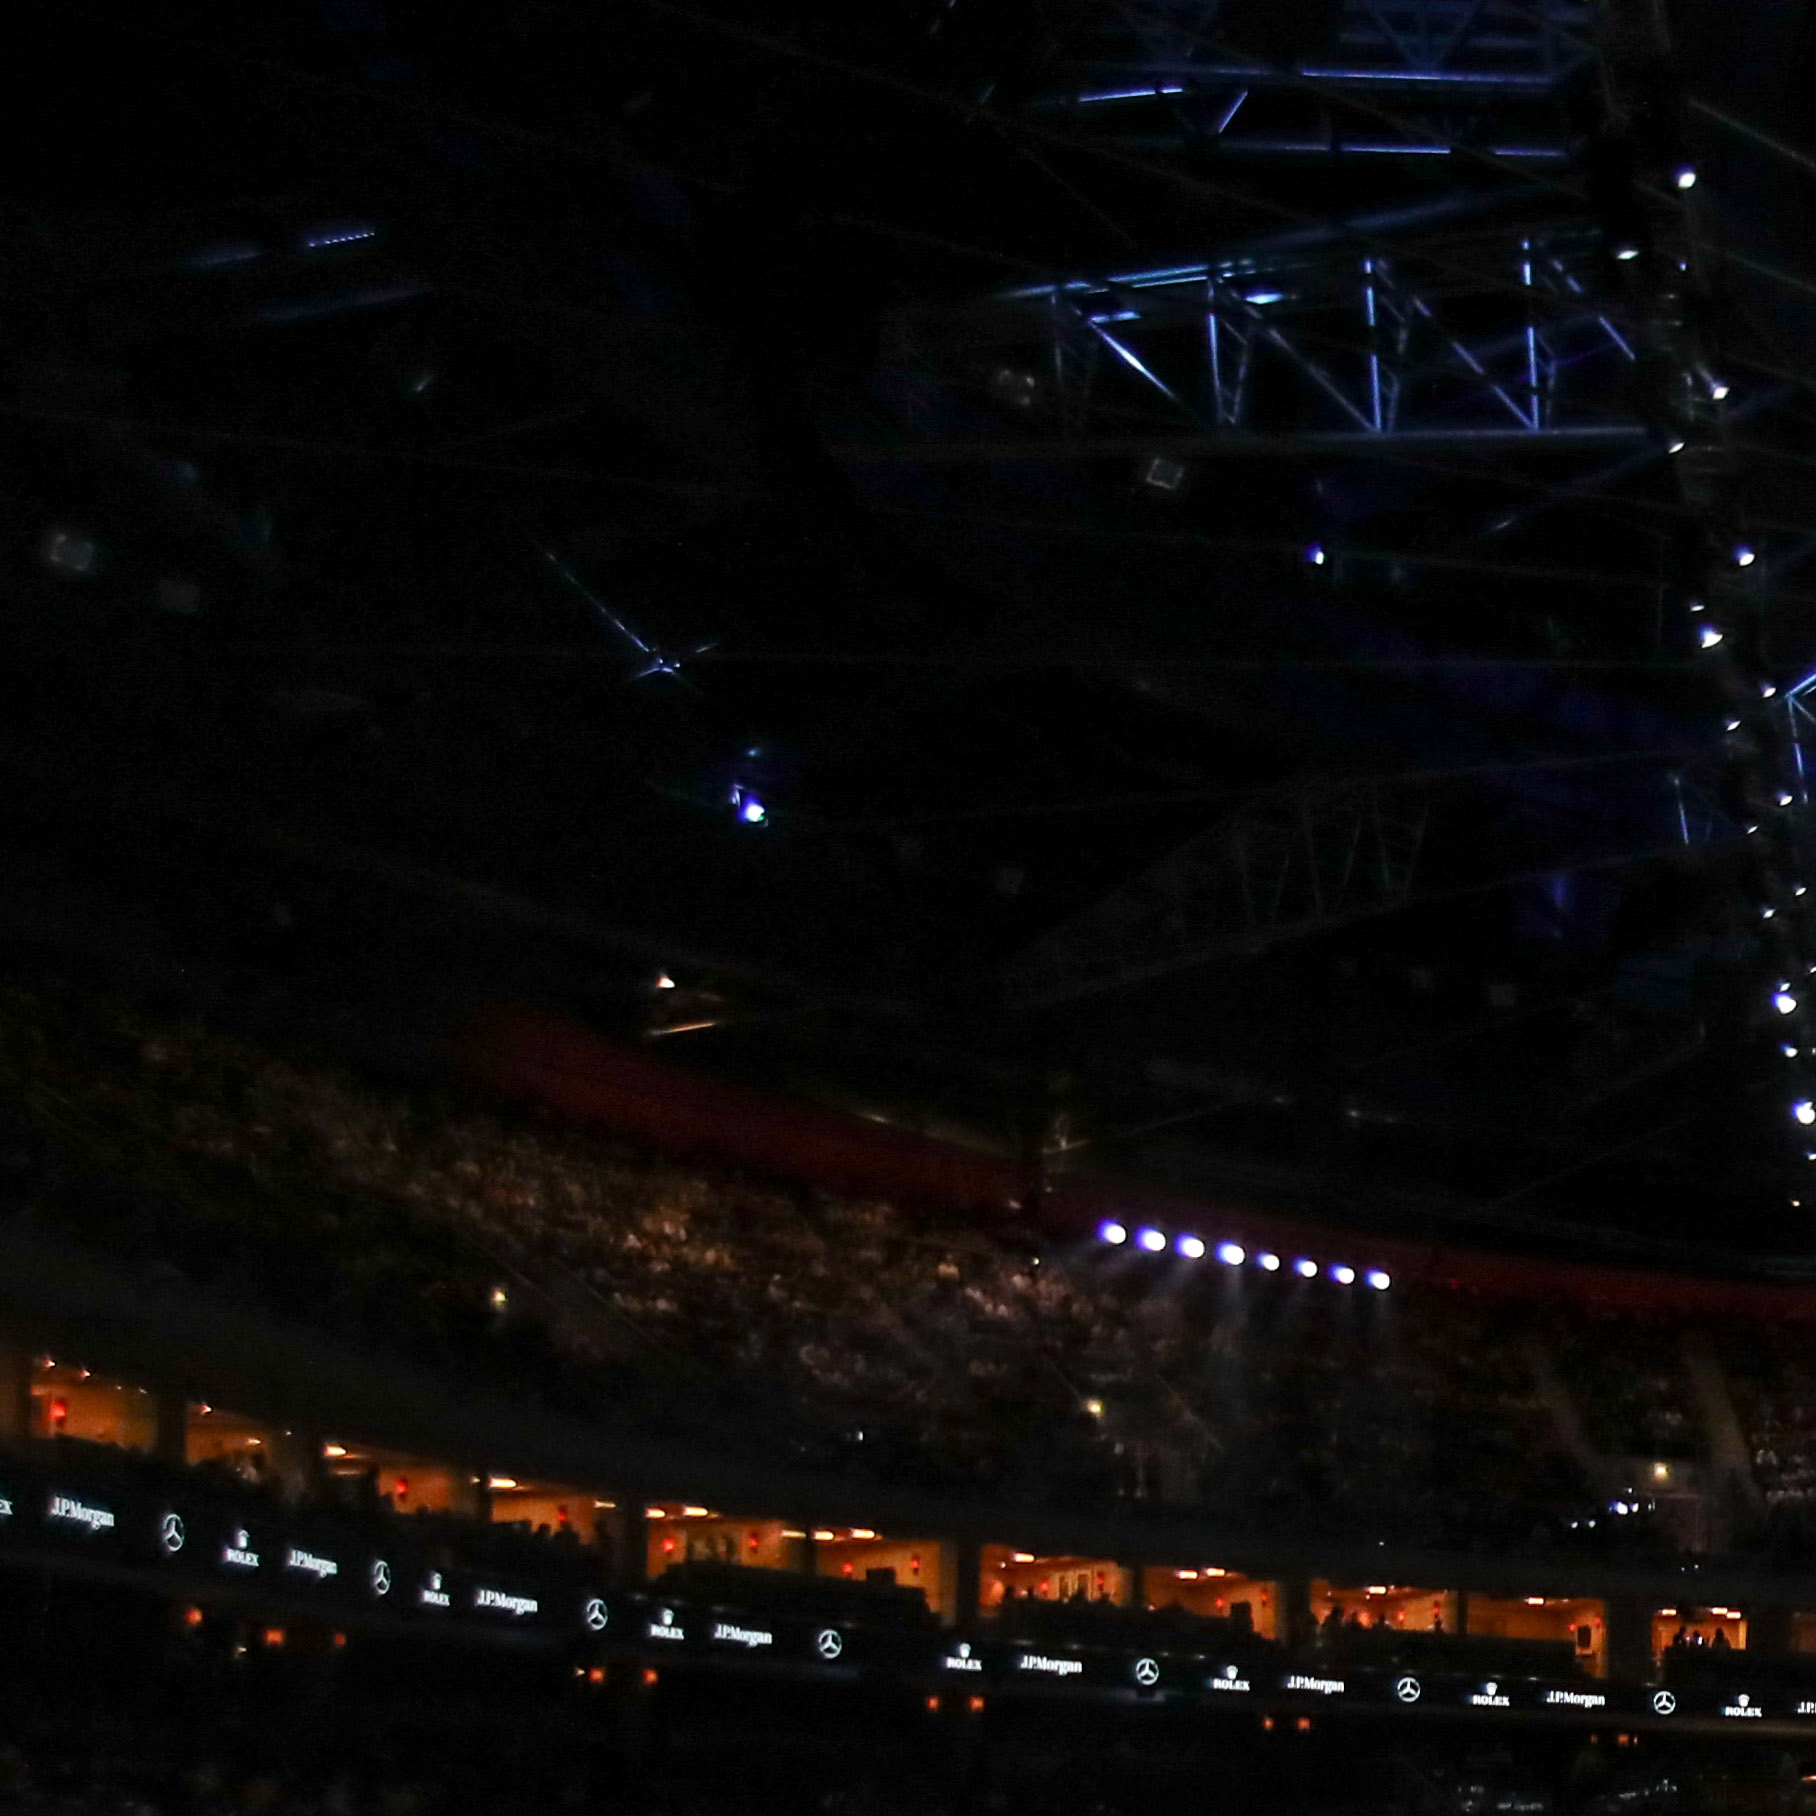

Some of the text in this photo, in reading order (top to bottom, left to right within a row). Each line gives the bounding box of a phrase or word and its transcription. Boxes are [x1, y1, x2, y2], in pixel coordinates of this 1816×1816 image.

[225, 1548, 259, 1566] ROLEX
[422, 1590, 450, 1606] ROLEX
[651, 1624, 684, 1639] ROLEX
[946, 1656, 982, 1670] ROLEX
[1021, 1655, 1082, 1675] J.P.Morgan
[1212, 1678, 1250, 1691] ROLEX
[1287, 1676, 1344, 1694] J.P.Morgan
[1472, 1694, 1509, 1706] ROLEX
[1546, 1691, 1605, 1707] J.P.Morgan
[1725, 1705, 1762, 1717] ROLEX
